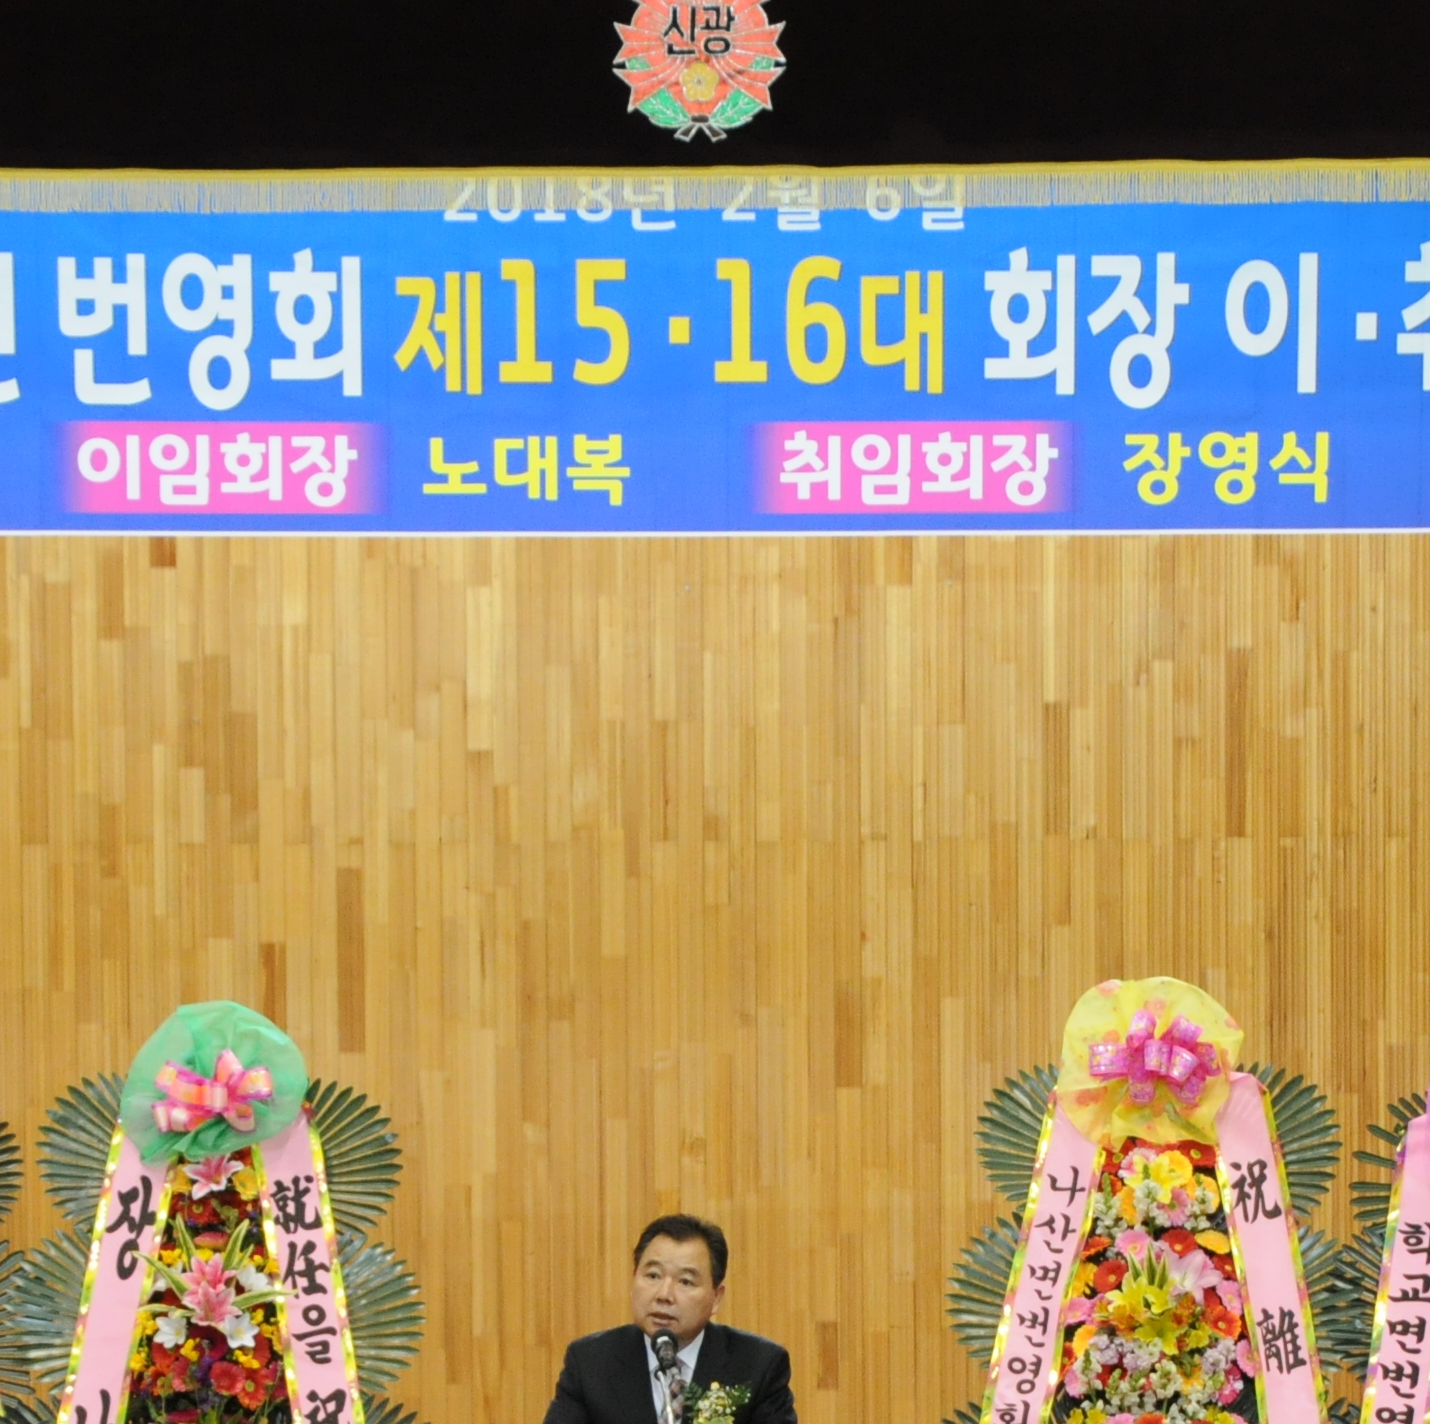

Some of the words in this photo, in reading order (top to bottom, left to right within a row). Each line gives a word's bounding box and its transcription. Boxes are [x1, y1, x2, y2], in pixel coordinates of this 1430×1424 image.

[663, 5, 735, 55] 신광
[57, 247, 362, 409] 번영회
[983, 247, 1190, 409] 회장
[77, 432, 358, 507] 이임회장
[423, 434, 630, 507] 노대복
[779, 430, 1059, 506] 취임회장
[1123, 431, 1331, 505] 장영식
[1230, 1158, 1283, 1225] 祝
